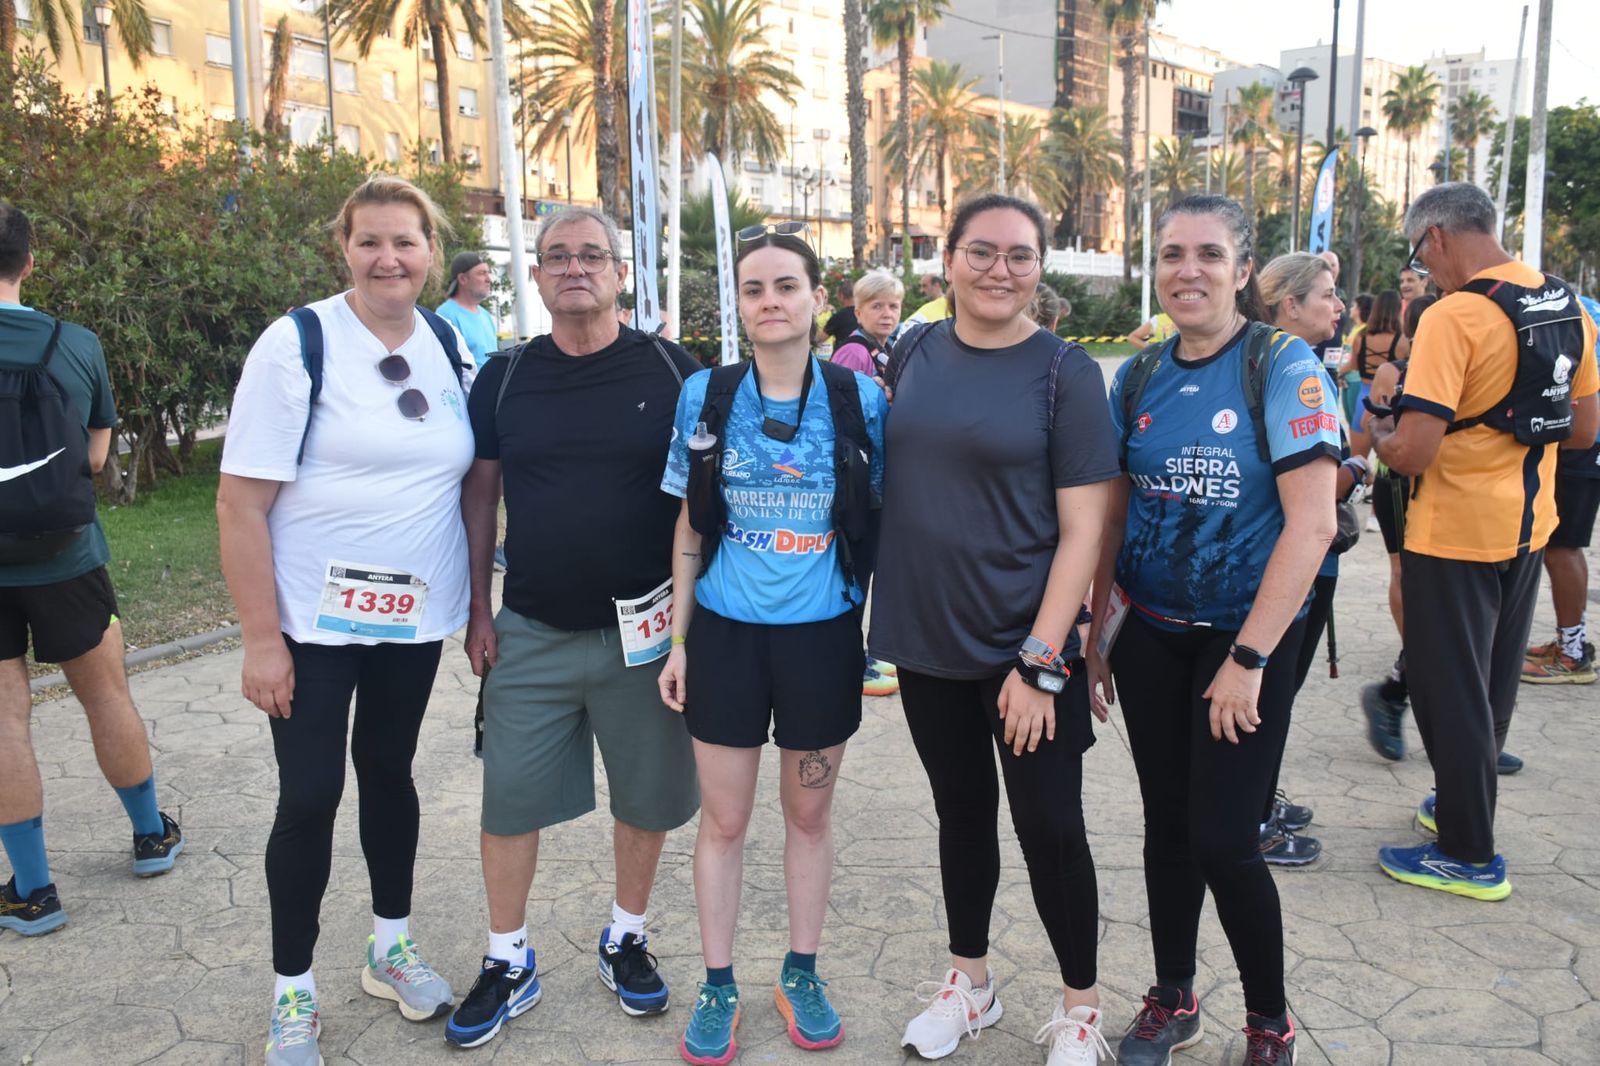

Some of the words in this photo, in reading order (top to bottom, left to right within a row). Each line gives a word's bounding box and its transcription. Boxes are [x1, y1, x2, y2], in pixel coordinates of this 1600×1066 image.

[1288, 411, 1338, 439] TECNOGAS
[1181, 446, 1236, 458] INTEGRAL
[1165, 458, 1241, 477] SIERRA
[1129, 472, 1240, 499] ULLONES
[725, 488, 785, 507] CARRERA
[340, 588, 415, 615] 1339
